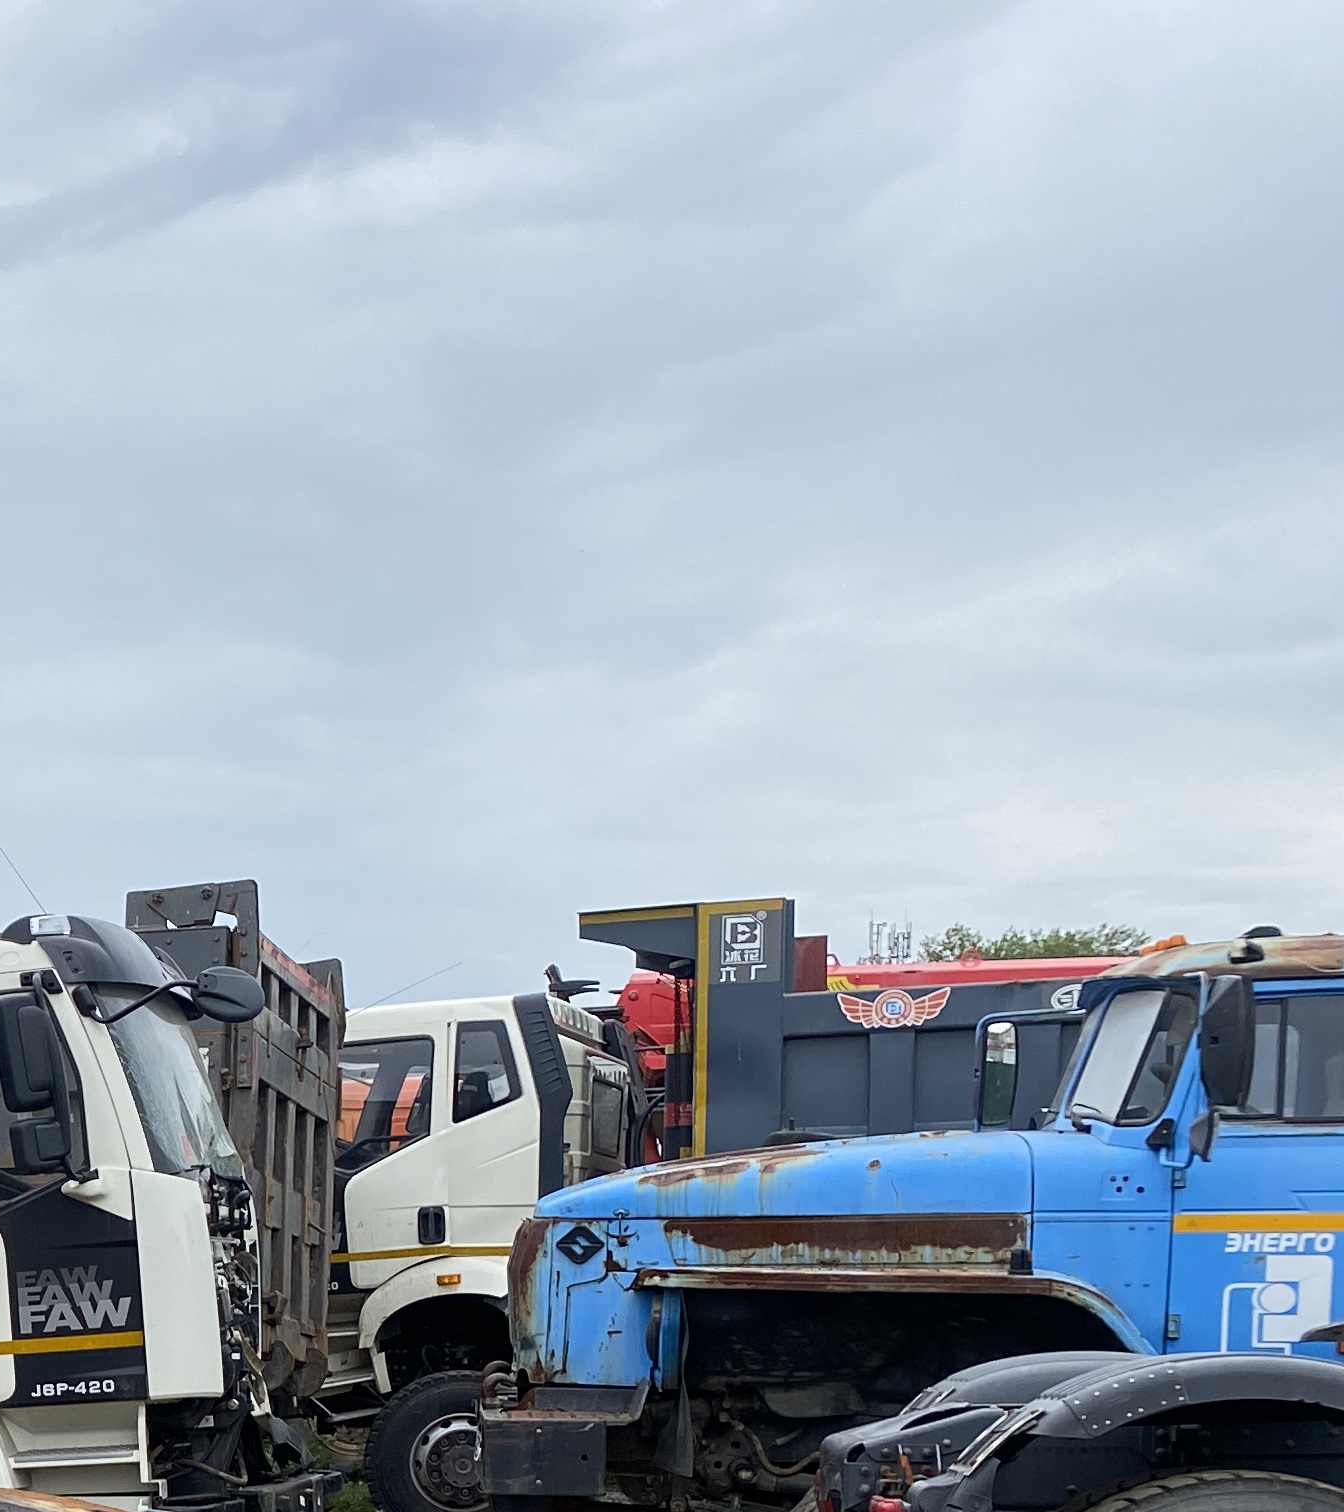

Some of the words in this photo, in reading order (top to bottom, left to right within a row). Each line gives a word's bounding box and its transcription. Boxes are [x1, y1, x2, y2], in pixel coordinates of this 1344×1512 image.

[1224, 1232, 1335, 1253] ЭНЕРГО
[19, 1297, 132, 1334] FAW
[31, 1380, 115, 1397] J6P-420
